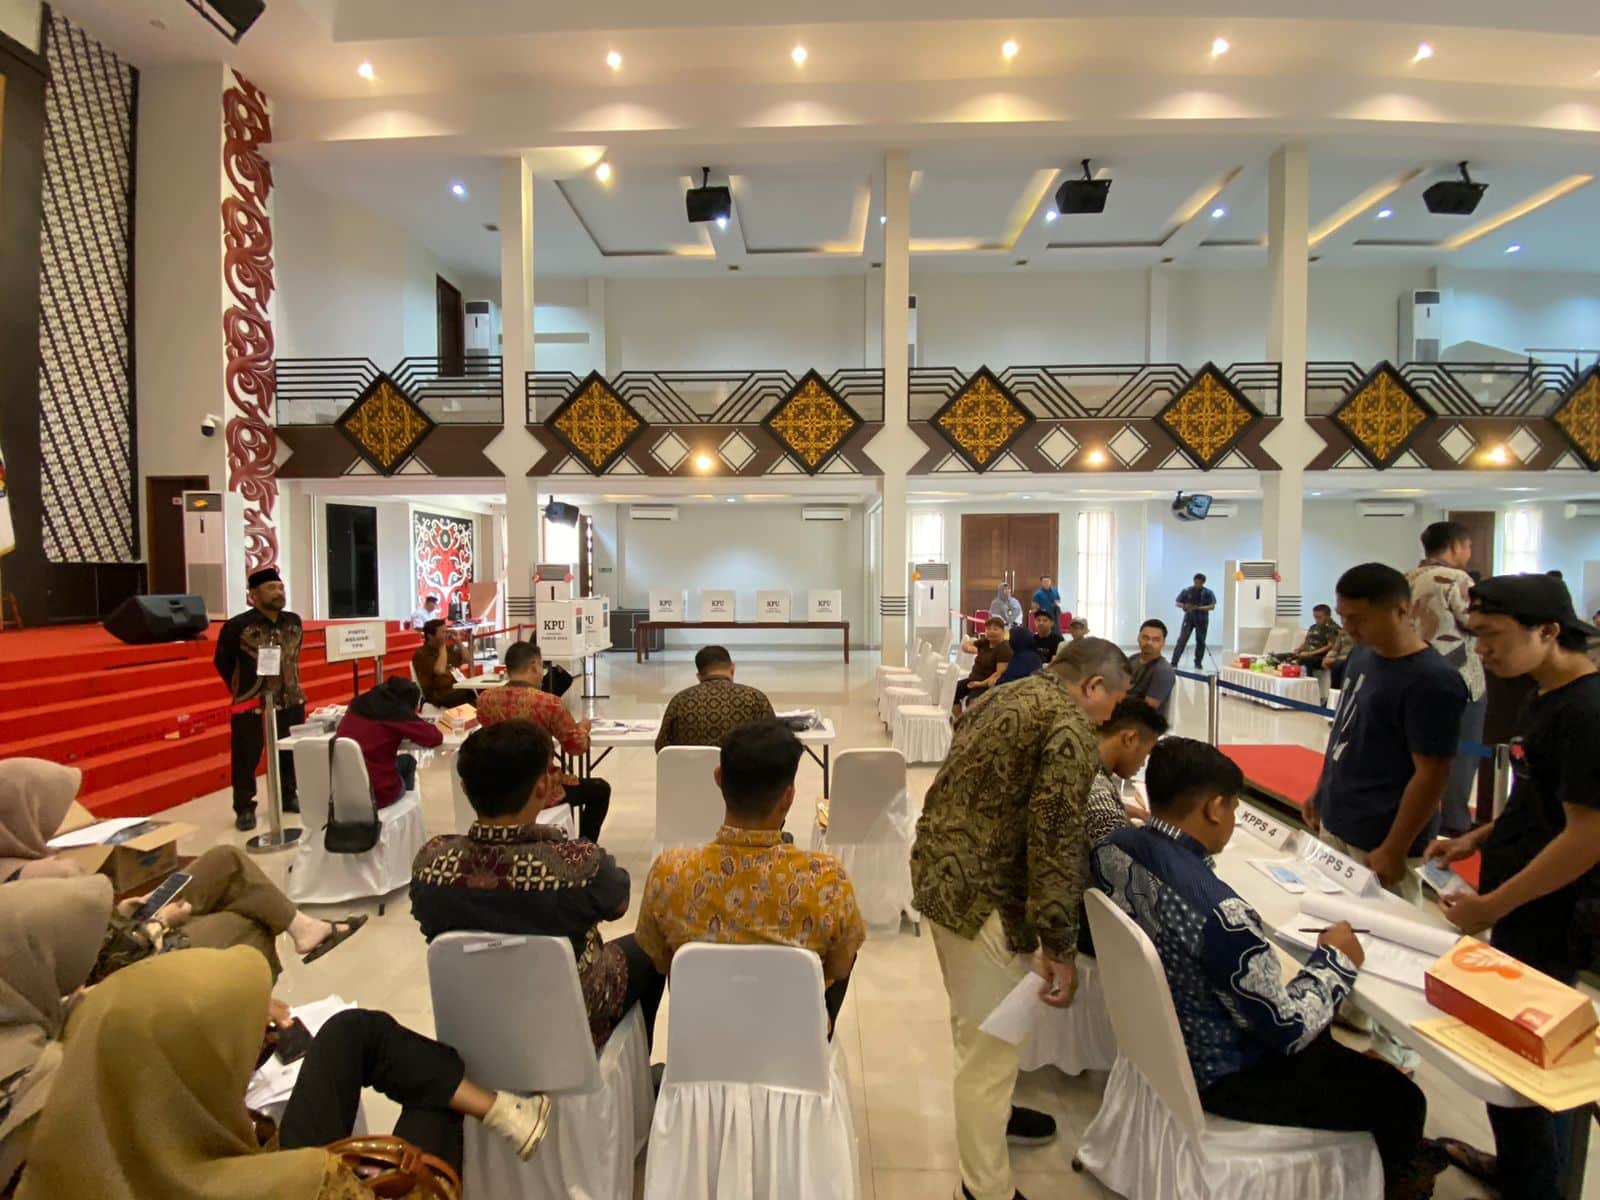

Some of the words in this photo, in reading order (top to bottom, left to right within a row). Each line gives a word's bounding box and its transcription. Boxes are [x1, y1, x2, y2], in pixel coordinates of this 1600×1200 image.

[659, 599, 672, 607] KPU
[711, 599, 725, 607] KPU
[818, 599, 832, 607] KPU
[543, 619, 565, 631] KPU
[1242, 811, 1268, 832] KPPS
[1268, 828, 1277, 837] 4
[1344, 866, 1355, 879] 5
